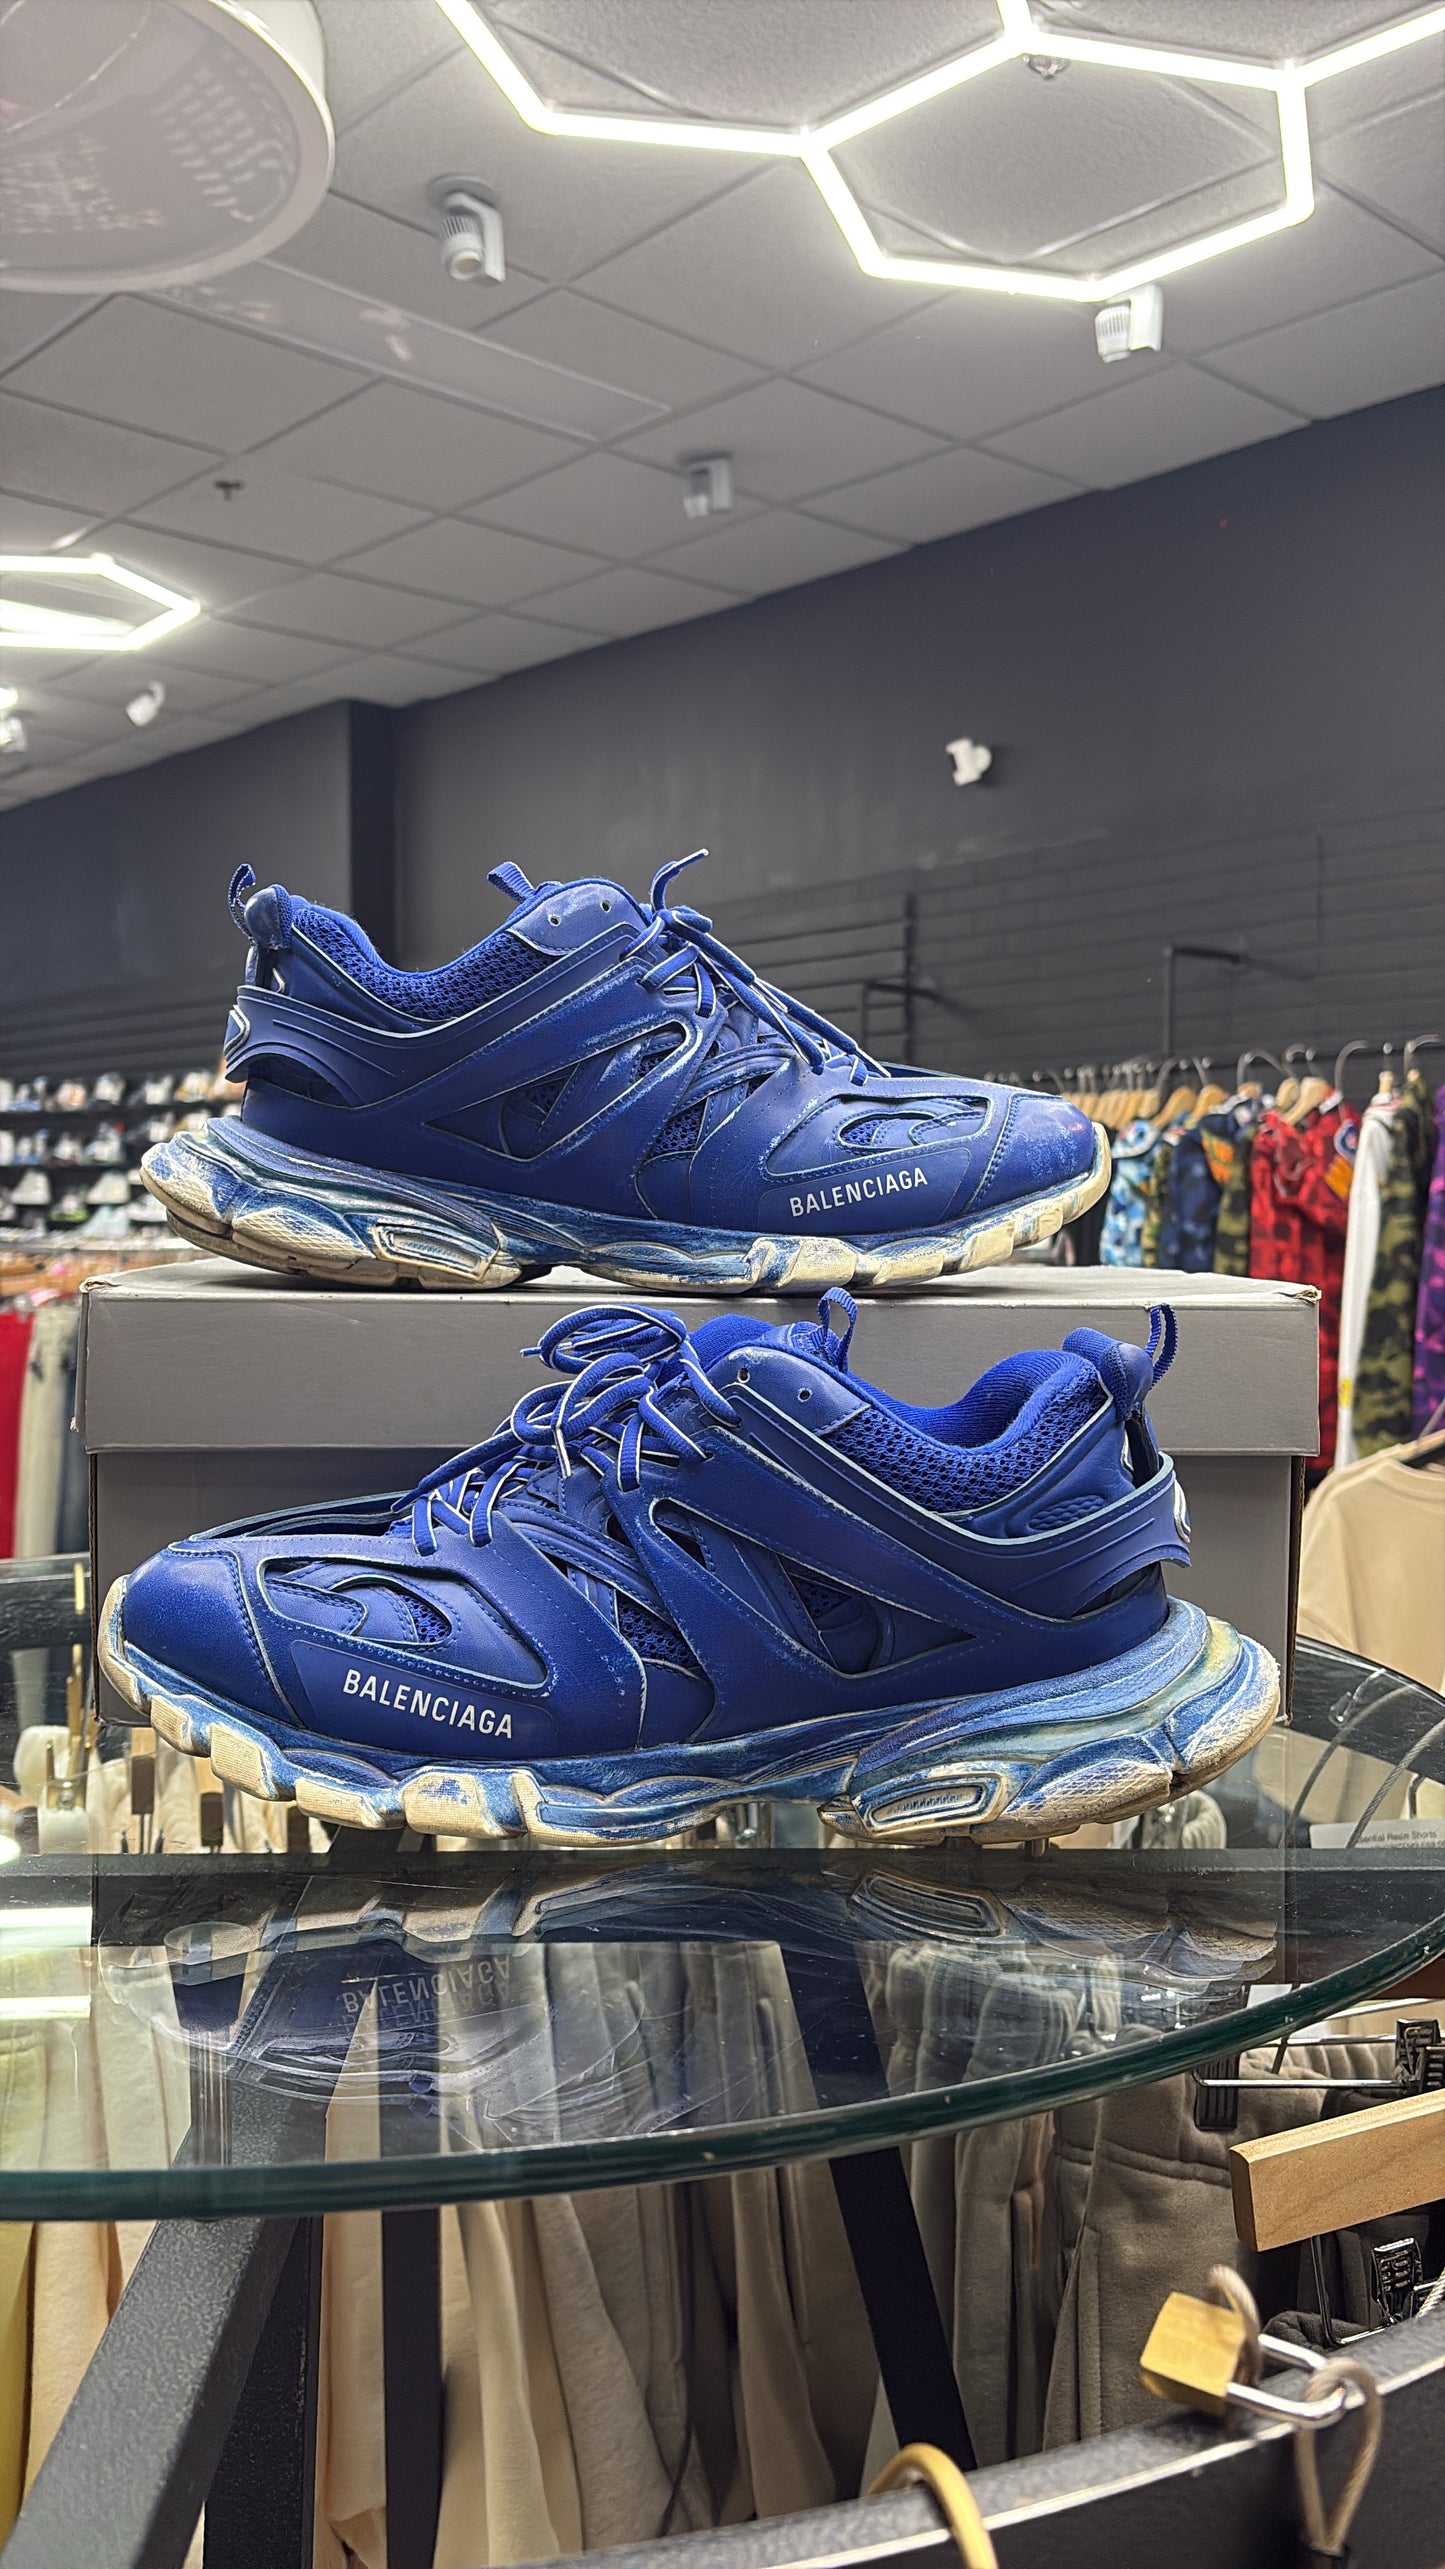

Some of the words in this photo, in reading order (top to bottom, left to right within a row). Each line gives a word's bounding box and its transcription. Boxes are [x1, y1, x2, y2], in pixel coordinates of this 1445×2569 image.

[789, 1167, 929, 1217] BALENCIAGA
[342, 1669, 512, 1739] BALENCIAGA
[1411, 1830, 1438, 1840] Shorts
